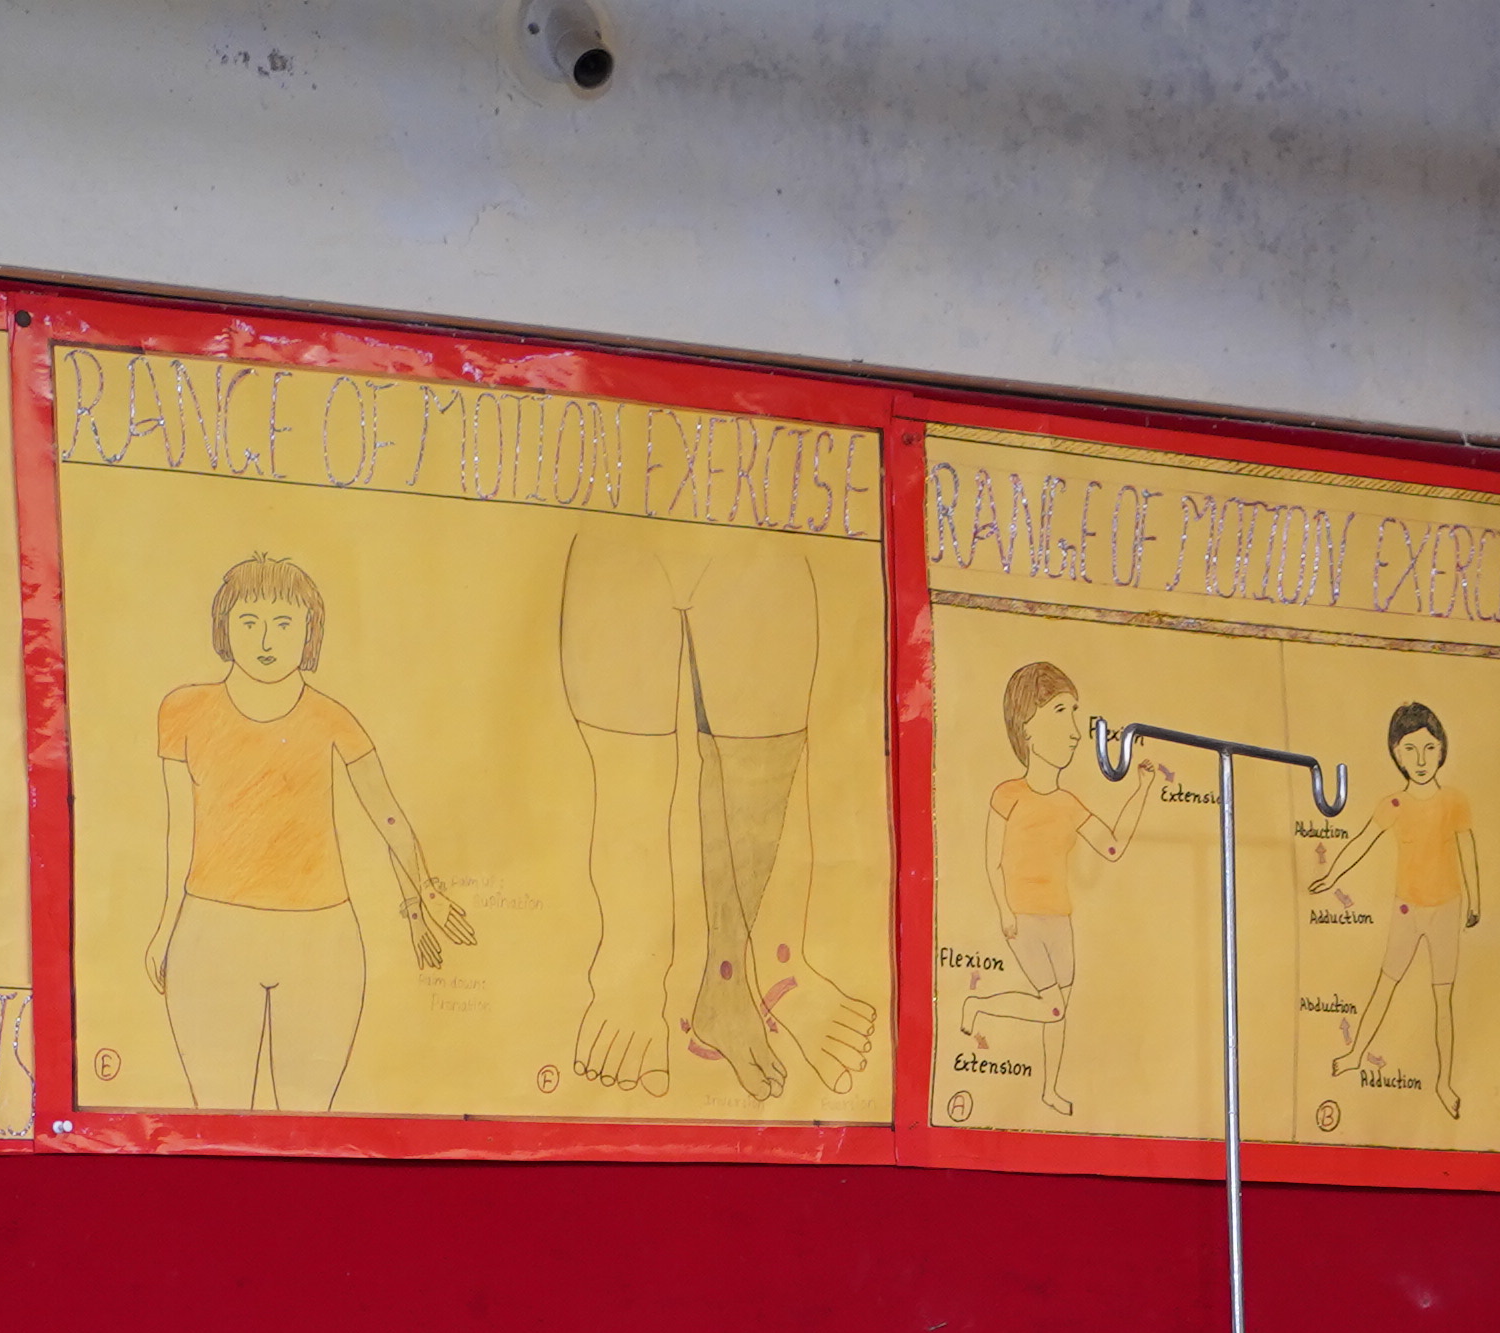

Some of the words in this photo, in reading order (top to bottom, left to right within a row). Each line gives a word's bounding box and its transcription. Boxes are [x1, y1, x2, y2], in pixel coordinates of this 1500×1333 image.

[62, 350, 293, 478] RANGE
[323, 376, 400, 489] OF
[406, 385, 626, 509] MOTION
[644, 407, 870, 538] EXERCISE
[930, 462, 1102, 584] RANGE
[1112, 484, 1163, 588] OF
[1165, 494, 1355, 607] MOTION
[1294, 819, 1350, 840] Abduction
[1309, 909, 1375, 925] Adduction
[939, 947, 1005, 971] Flexion
[1299, 993, 1358, 1015] Abduction
[953, 1052, 1033, 1078] Extension
[1359, 1068, 1422, 1090] Adduction
